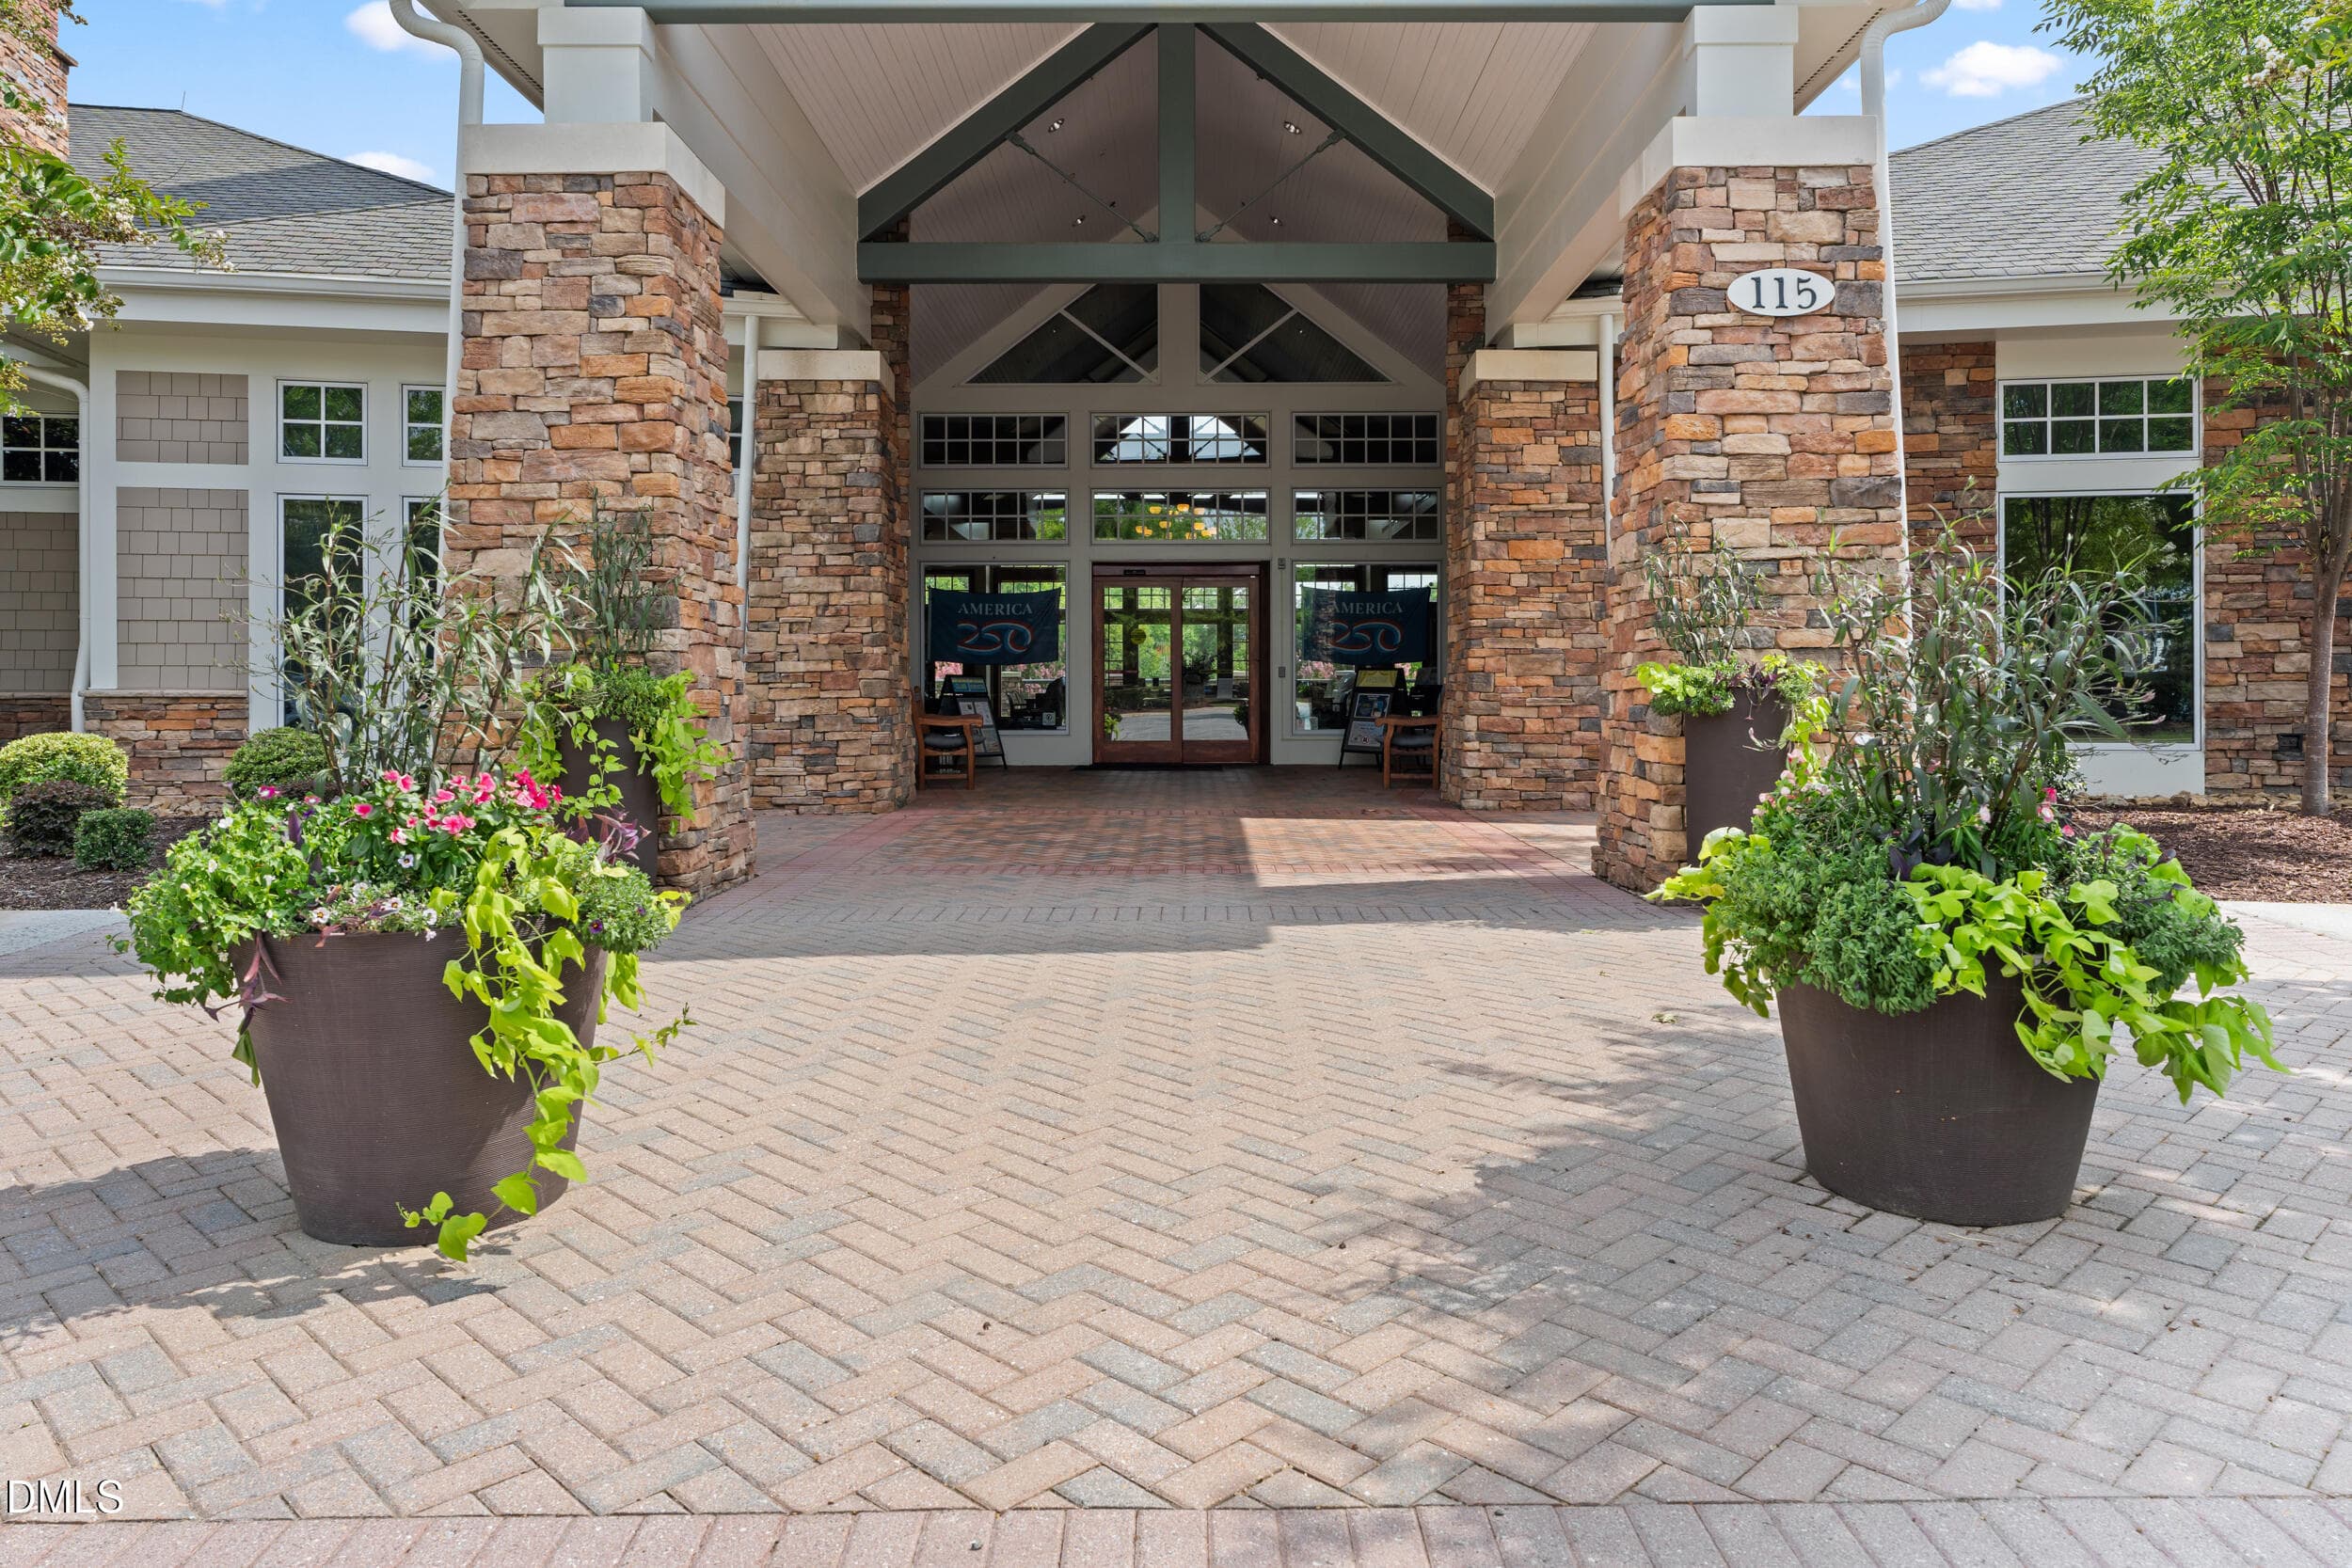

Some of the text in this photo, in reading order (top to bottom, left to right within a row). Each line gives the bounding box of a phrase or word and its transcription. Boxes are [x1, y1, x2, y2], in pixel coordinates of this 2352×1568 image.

[1750, 276, 1818, 309] 115
[957, 602, 1034, 616] AMERICA
[1328, 601, 1404, 615] AMERICA
[956, 619, 1035, 656] 250
[1327, 618, 1404, 656] 250
